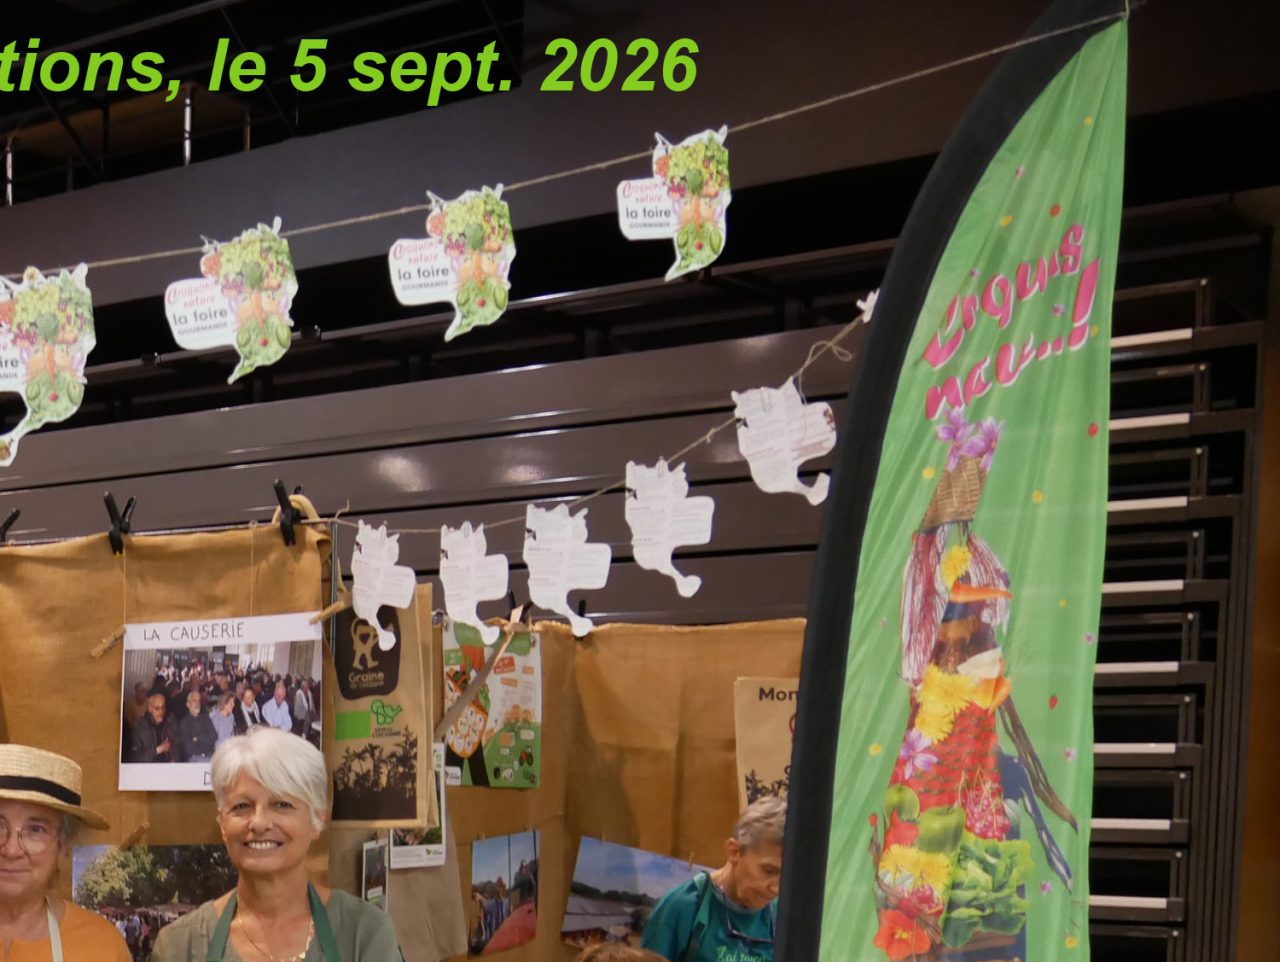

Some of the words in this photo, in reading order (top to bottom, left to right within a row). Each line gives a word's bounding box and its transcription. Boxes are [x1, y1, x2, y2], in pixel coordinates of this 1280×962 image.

[626, 207, 638, 218] la
[643, 206, 670, 218] foire
[398, 269, 411, 281] la
[417, 266, 449, 278] foire
[173, 314, 188, 326] la
[193, 308, 228, 322] foire
[143, 629, 160, 641] LA
[170, 622, 245, 641] CAUSERIE
